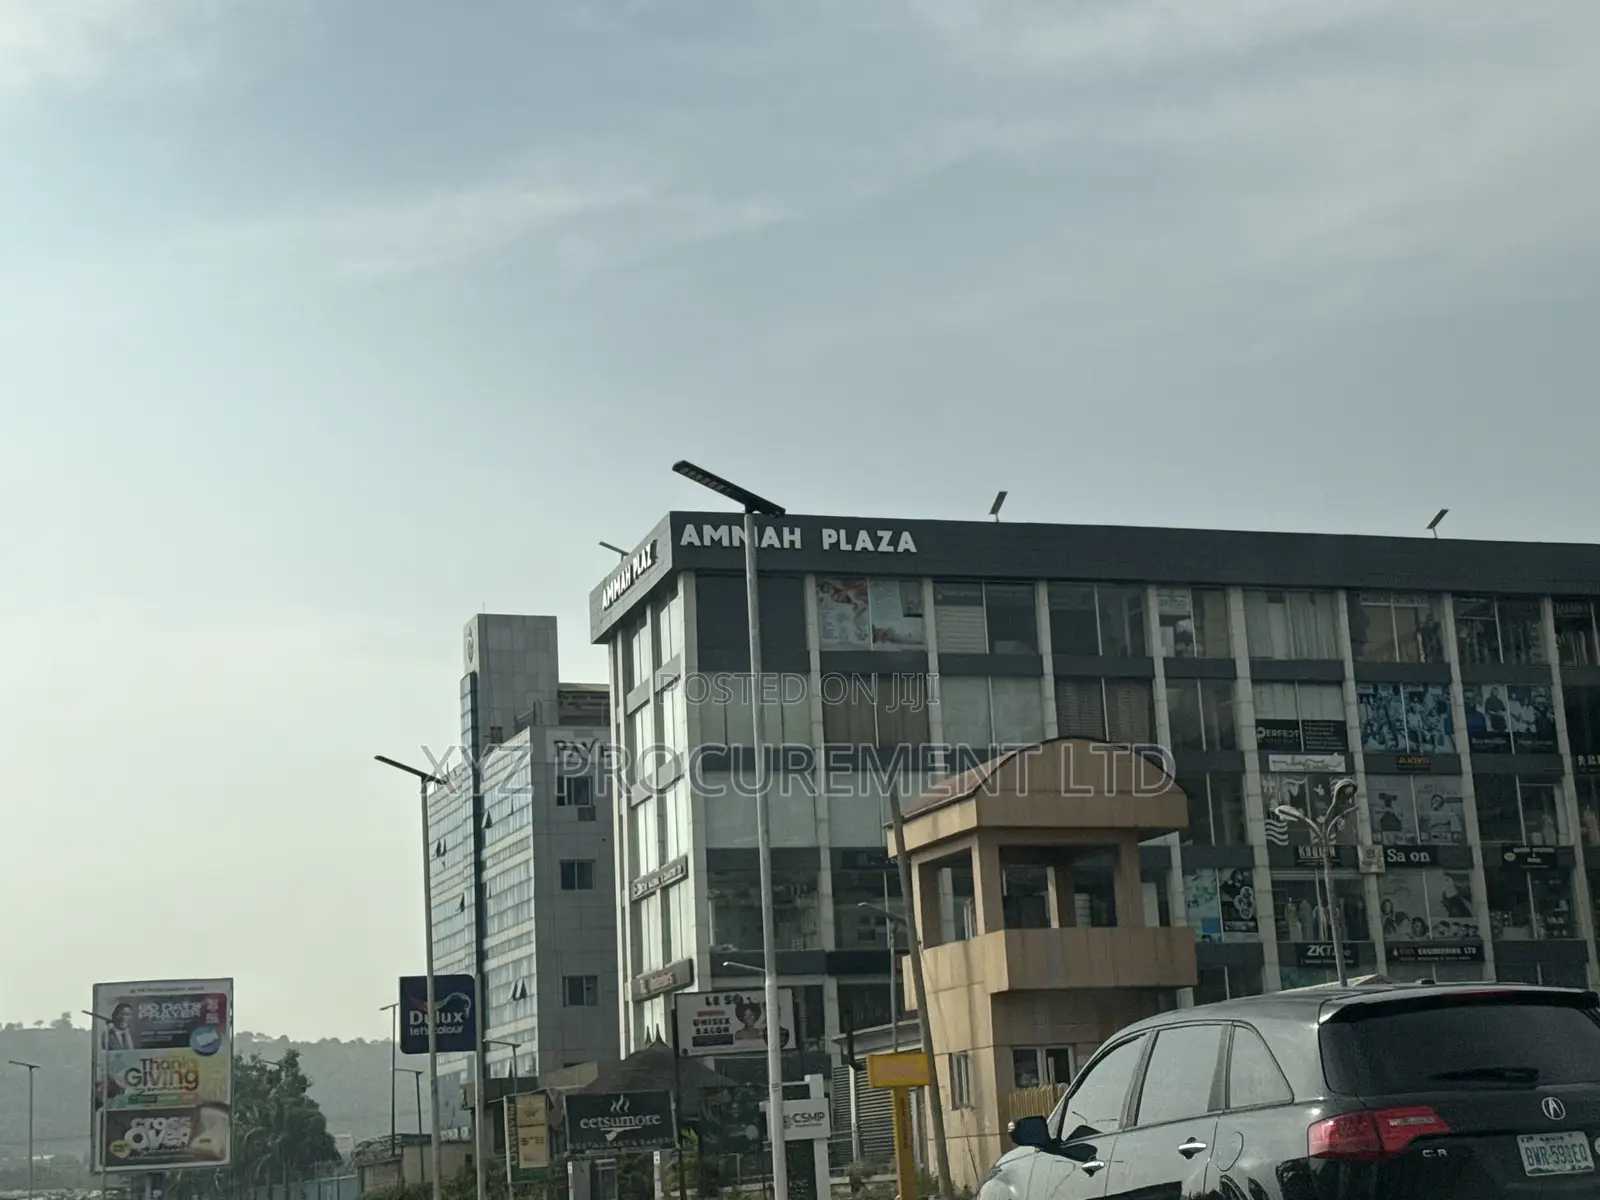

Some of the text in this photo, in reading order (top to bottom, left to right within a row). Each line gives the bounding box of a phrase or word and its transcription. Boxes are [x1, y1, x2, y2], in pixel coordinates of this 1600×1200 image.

[680, 524, 917, 553] AMMAH PLAZA
[434, 1025, 464, 1035] olour
[792, 1111, 826, 1123] CSMP
